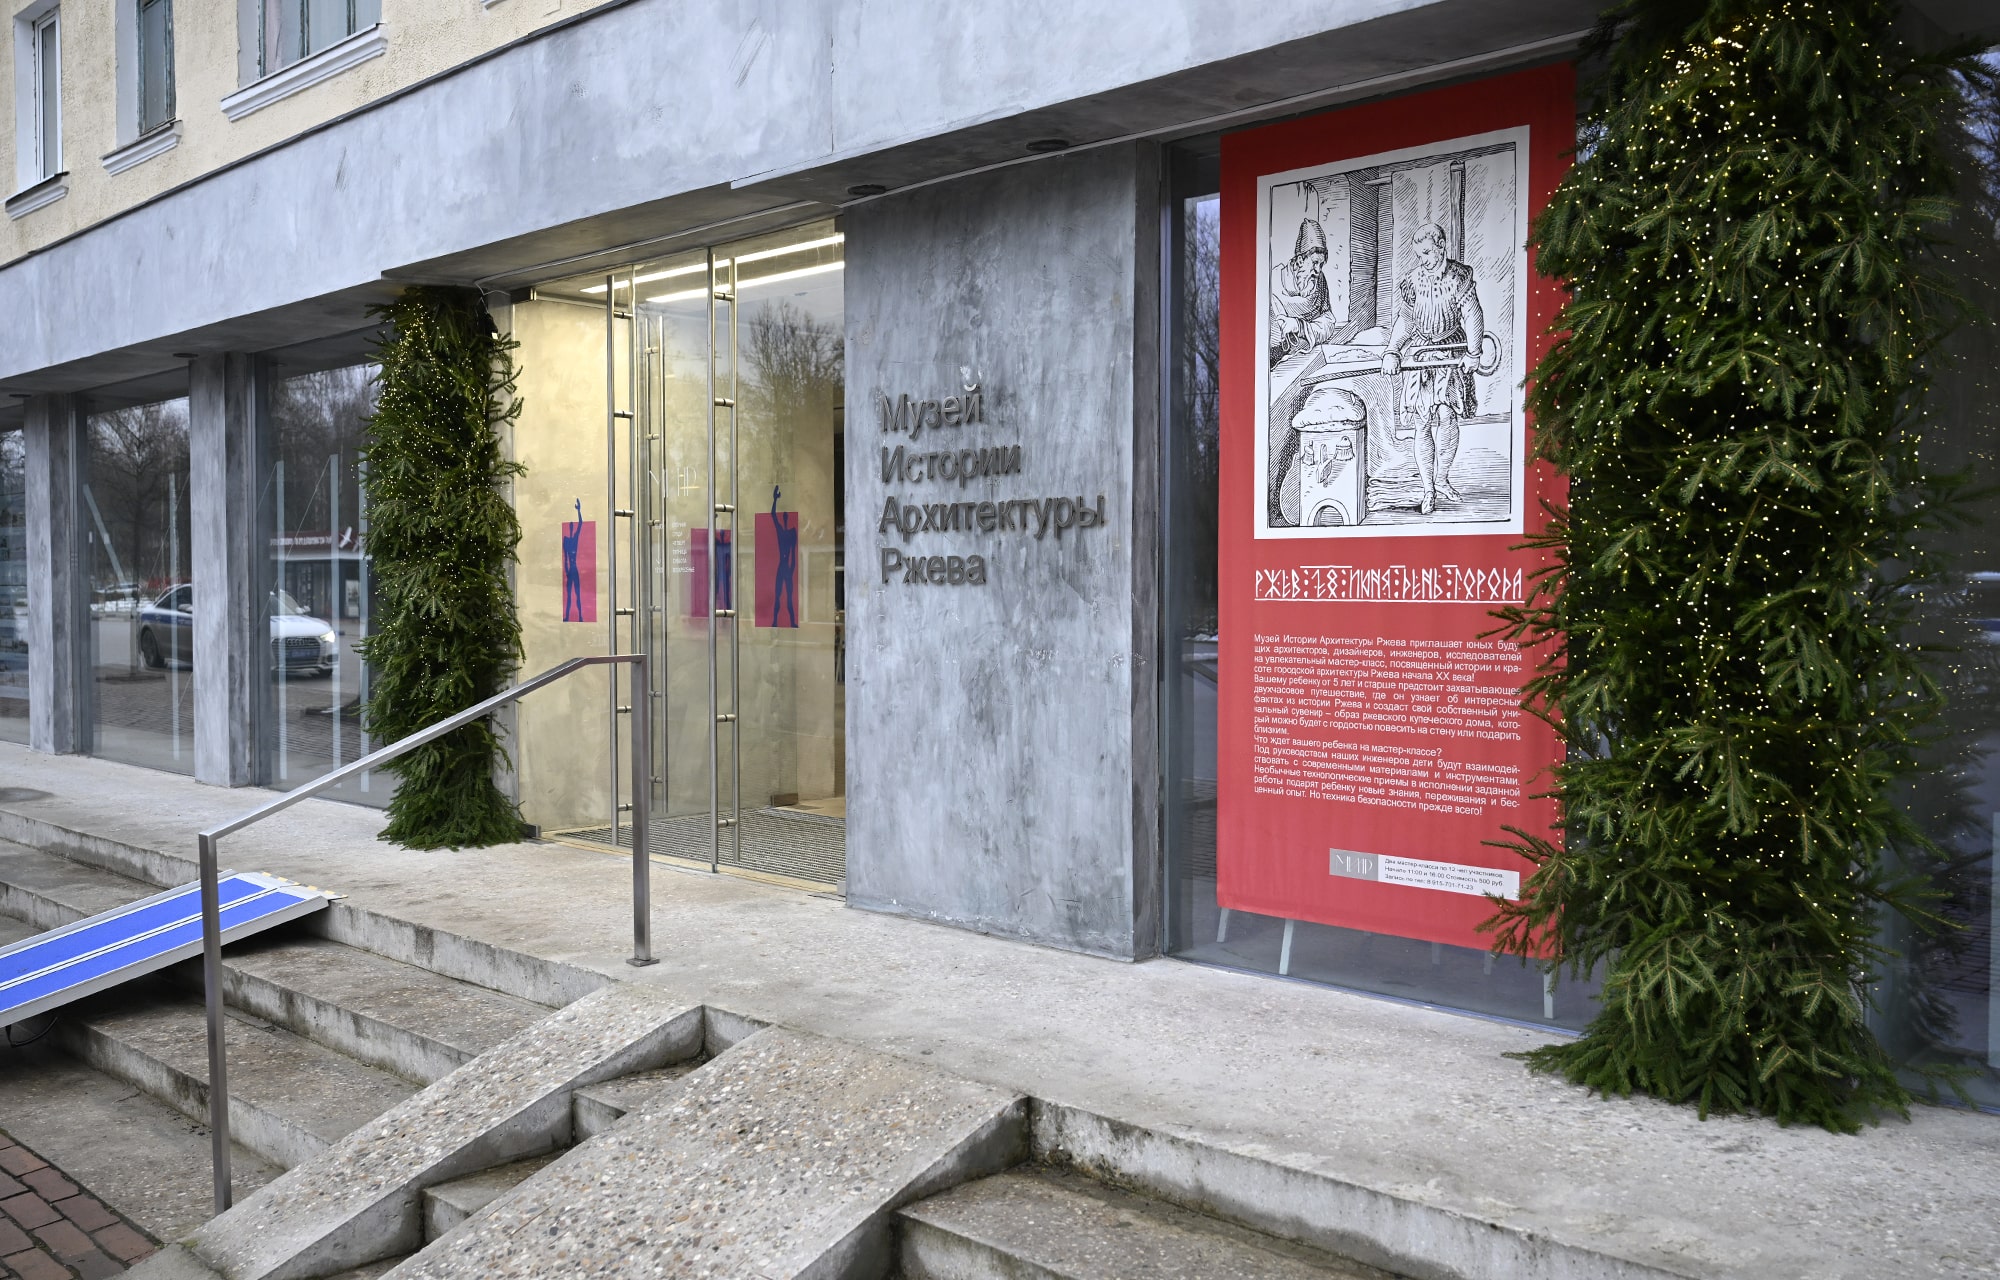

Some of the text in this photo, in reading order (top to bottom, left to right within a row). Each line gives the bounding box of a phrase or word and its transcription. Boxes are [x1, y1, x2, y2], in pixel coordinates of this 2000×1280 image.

[880, 383, 983, 440] Музей
[881, 444, 1021, 488] Истории
[879, 494, 1105, 542] Архитектуры
[881, 547, 987, 586] Ржева
[1454, 568, 1522, 600] ГОРОДА
[1254, 633, 1280, 644] Музей
[1283, 634, 1317, 645] Истории
[1319, 635, 1373, 647] Архитектуры
[1376, 636, 1406, 646] Ржева
[1409, 640, 1463, 648] приглашает
[1264, 656, 1326, 664] увлекательный
[1327, 658, 1387, 669] мастер-класс,
[1389, 660, 1452, 672] посвященный
[1454, 663, 1492, 673] истории
[1502, 664, 1522, 674] кра-
[1273, 646, 1329, 656] архитекторов,
[1332, 647, 1386, 657] дизайнеров,
[1389, 650, 1441, 659] инженеров,
[1445, 651, 1522, 661] исследователей
[1253, 673, 1287, 685] Вашему
[1288, 675, 1320, 687] ребенку
[1332, 677, 1338, 686] 5
[1363, 680, 1396, 690] старше
[1398, 682, 1444, 691] предстоит
[1273, 666, 1315, 677] городской
[1316, 668, 1369, 678] архитектуры
[1370, 668, 1399, 678] Ржева
[1401, 671, 1433, 680] начала
[1452, 672, 1474, 681] века!
[1253, 686, 1304, 694] двухчасовое
[1310, 688, 1366, 699] путешествие,
[1372, 692, 1386, 700] где
[1410, 694, 1440, 703] узнает
[1447, 693, 1458, 703] об
[1464, 696, 1522, 708] интересных
[1253, 695, 1283, 703] фактах
[1298, 698, 1330, 707] истории
[1334, 698, 1362, 708] Ржева
[1373, 702, 1409, 711] создаст
[1411, 702, 1432, 712] свой
[1436, 704, 1497, 716] собственный
[1501, 709, 1521, 719] уни-
[1253, 715, 1270, 725] рый
[1271, 717, 1298, 725] можно
[1299, 716, 1321, 727] будет
[1329, 720, 1373, 730] гордостью
[1374, 724, 1416, 733] повесить
[1429, 727, 1456, 738] стену
[1476, 730, 1521, 740] подарить
[1253, 724, 1289, 734] близким.
[1290, 707, 1323, 718] сувенир
[1334, 708, 1360, 719] образ
[1362, 712, 1407, 722] ржевского
[1409, 715, 1463, 725] купеческого
[1465, 718, 1493, 728] дома,
[1497, 720, 1521, 729] кото-
[1253, 734, 1268, 743] Что
[1269, 737, 1290, 745] ждет
[1292, 738, 1321, 747] вашего
[1322, 739, 1357, 750] ребенка
[1371, 745, 1442, 759] мастер-классе?
[1254, 744, 1520, 774] Под руководством наших инженеров дети будут взаимодей-
[1253, 756, 1289, 765] ствовать
[1302, 760, 1365, 771] современными
[1369, 766, 1429, 777] материалами
[1445, 772, 1520, 789] инструментами.
[1254, 764, 1301, 776] Необычные
[1302, 770, 1371, 783] технологические
[1373, 777, 1408, 786] приемы
[1418, 781, 1472, 792] исполнении
[1474, 786, 1520, 799] заданной
[1253, 774, 1283, 788] работы
[1286, 778, 1319, 790] подарят
[1321, 781, 1356, 793] ребенку
[1358, 786, 1385, 794] новые
[1388, 788, 1421, 799] знания,
[1424, 792, 1486, 807] переживания
[1500, 797, 1520, 807] бес-
[1254, 786, 1482, 815] ценный опыт. Но техника безопасности прежде всего!
